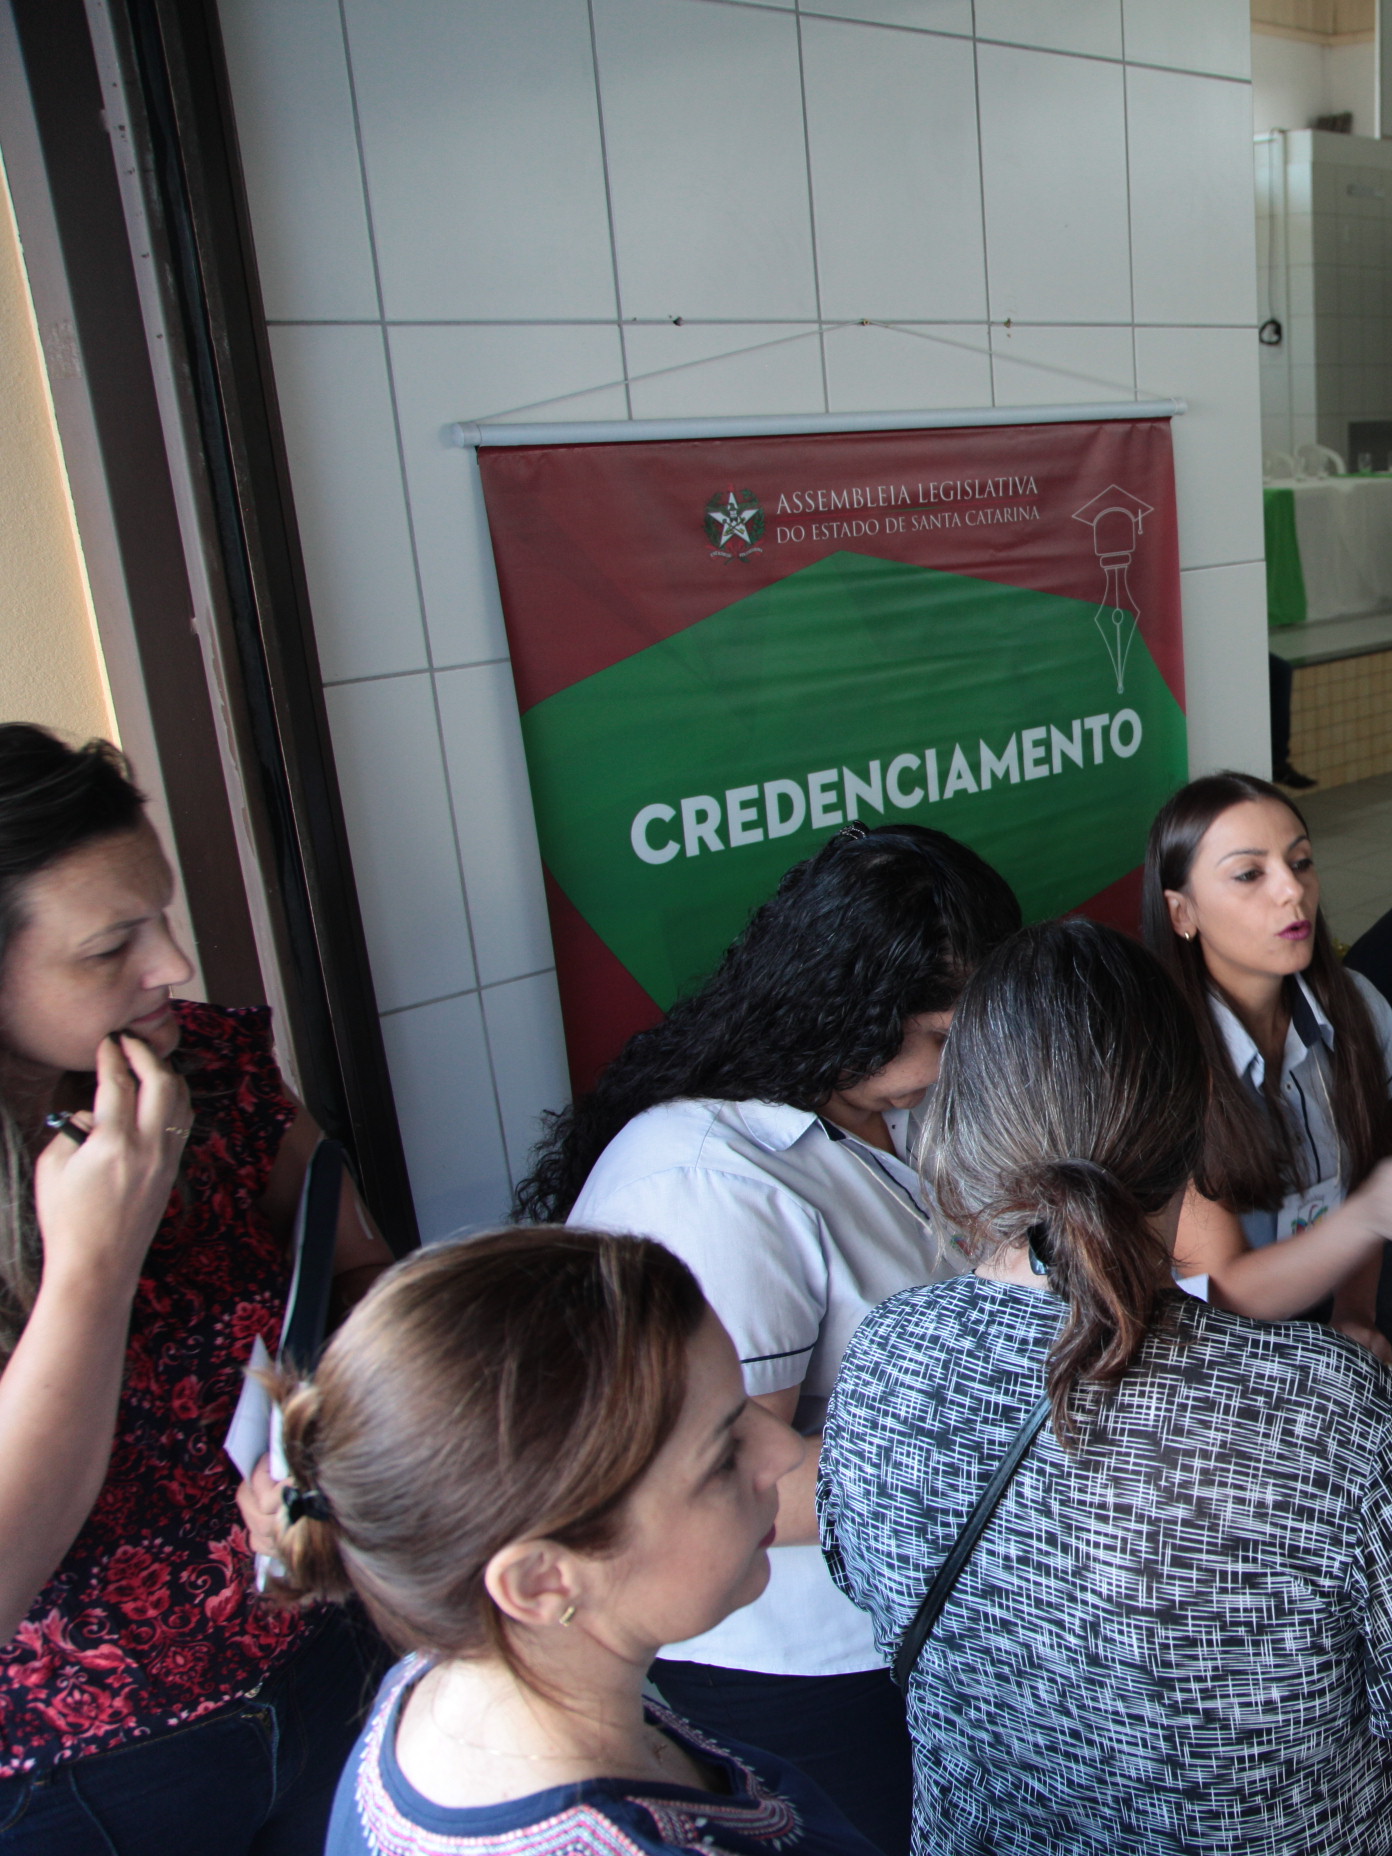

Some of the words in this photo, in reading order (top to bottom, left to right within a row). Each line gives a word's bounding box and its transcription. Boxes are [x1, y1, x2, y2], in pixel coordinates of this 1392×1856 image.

[776, 484, 911, 515] ASSEMBLEIA
[918, 475, 1038, 504] LEGISLATIVA
[776, 525, 805, 544] DO
[812, 518, 879, 541] ESTADO
[885, 516, 906, 534] DE
[911, 511, 962, 532] SANTA
[965, 505, 1040, 526] CATARINA
[629, 707, 1143, 866] CREDENCIAMENTO
